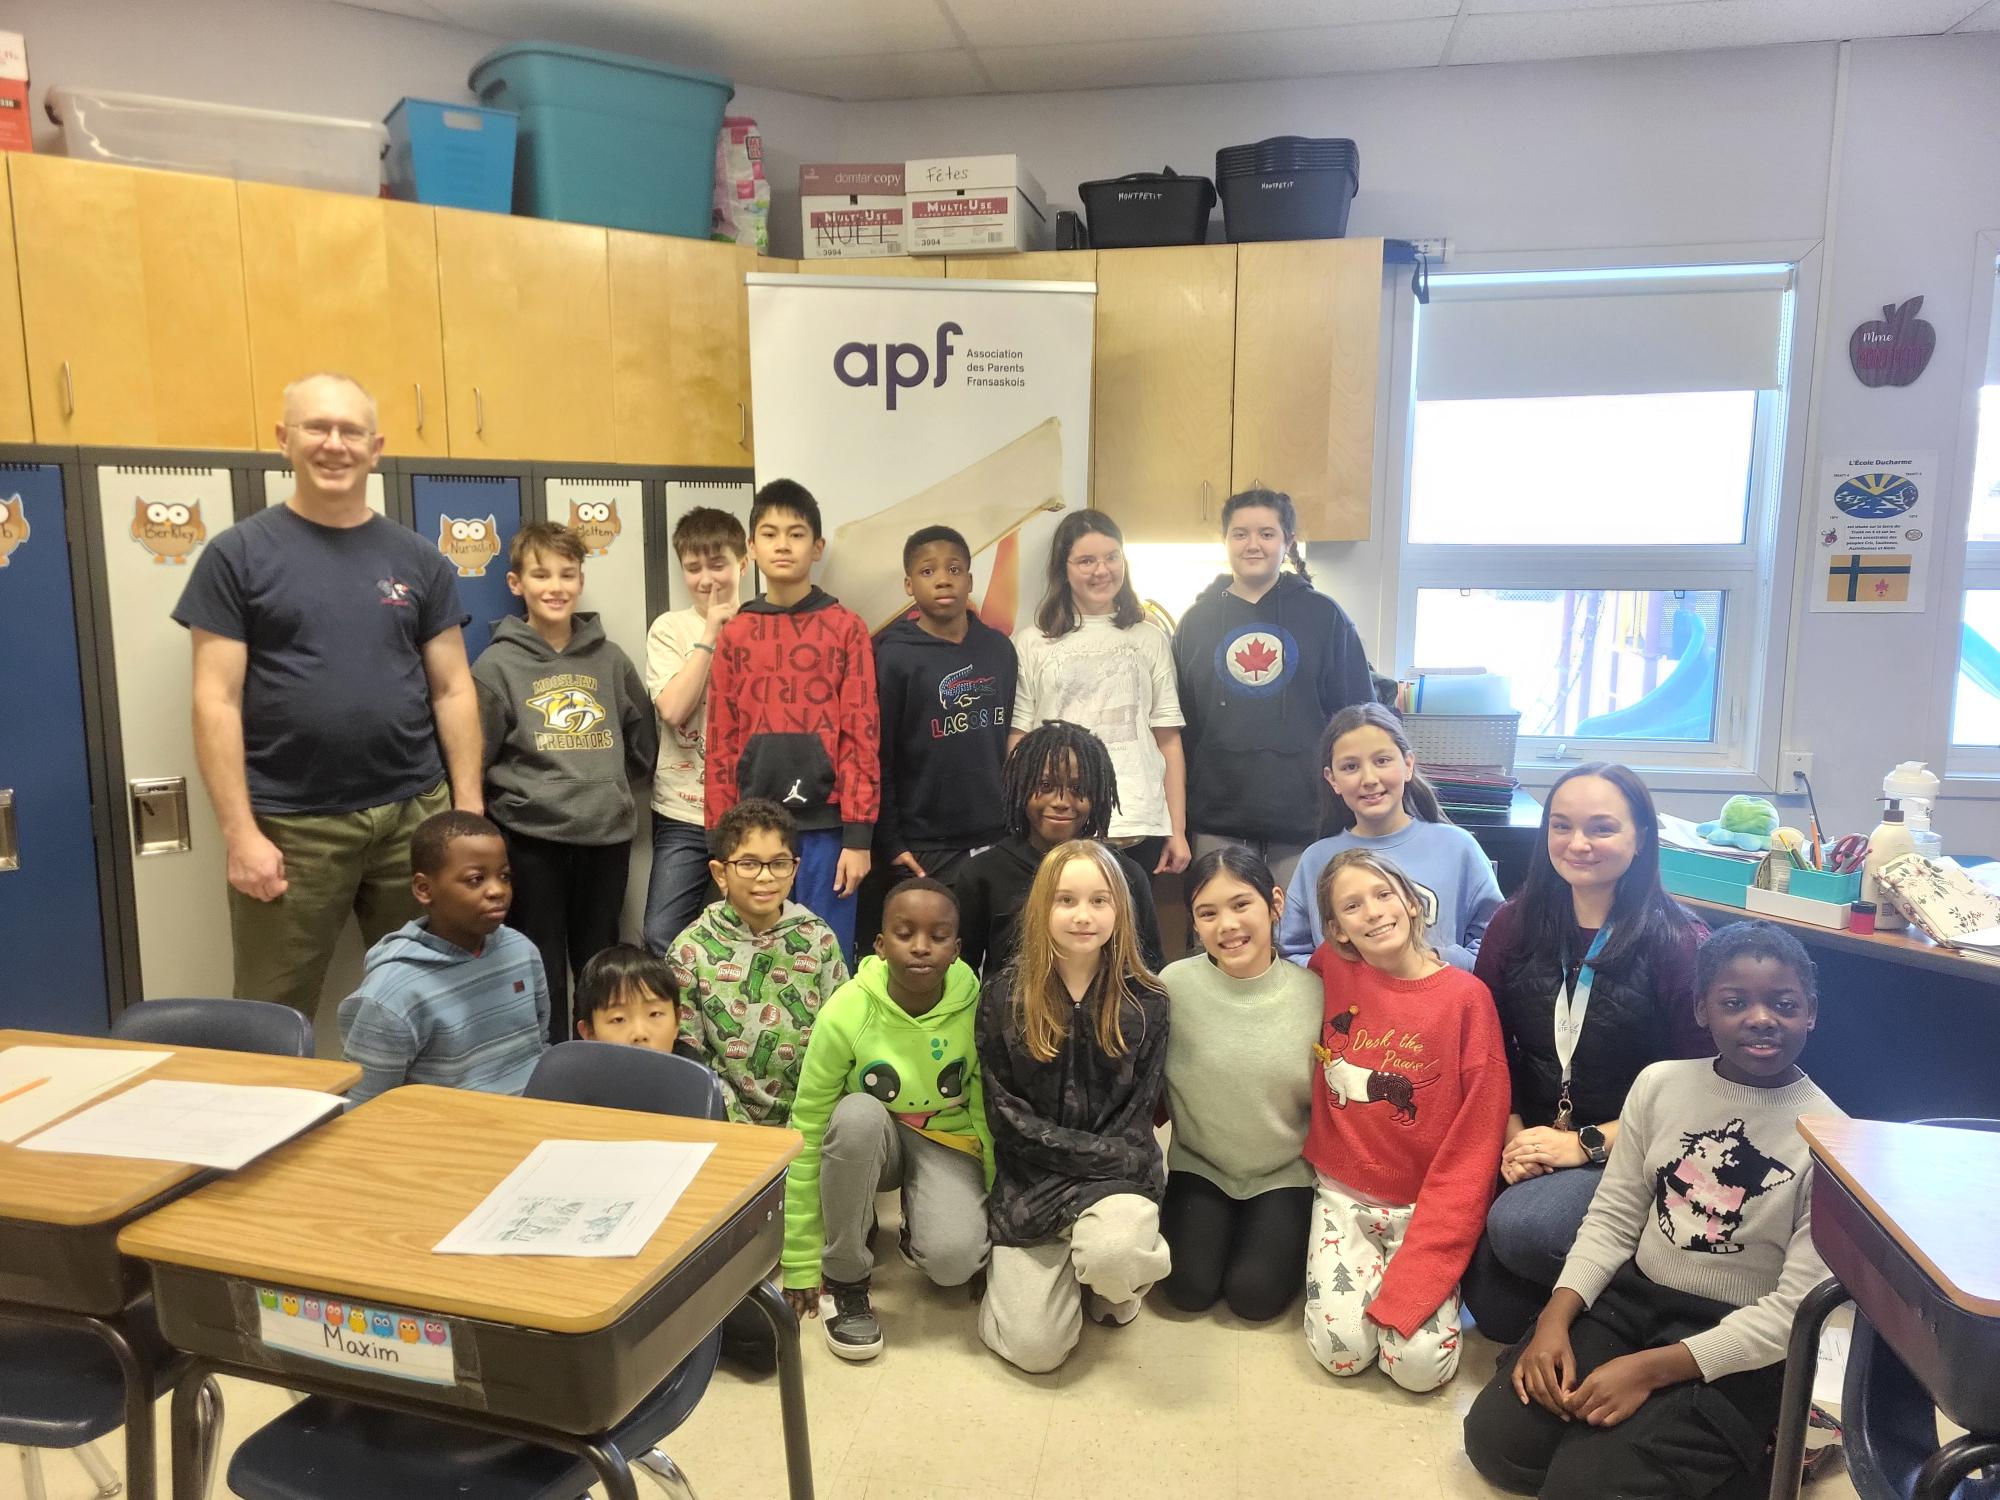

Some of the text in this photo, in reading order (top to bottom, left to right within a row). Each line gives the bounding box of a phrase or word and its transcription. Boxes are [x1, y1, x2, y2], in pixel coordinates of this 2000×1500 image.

[873, 173, 901, 186] copy
[1863, 331, 1893, 343] Mme
[966, 348, 1023, 360] Association
[833, 321, 963, 410] apf
[966, 362, 1025, 373] des Parents
[966, 376, 1026, 388] Fransaskois
[1875, 458, 1912, 466] Ducharme
[534, 729, 613, 751] PREDATORS
[1400, 1033, 1424, 1052] the
[323, 1323, 399, 1362] Maxim
